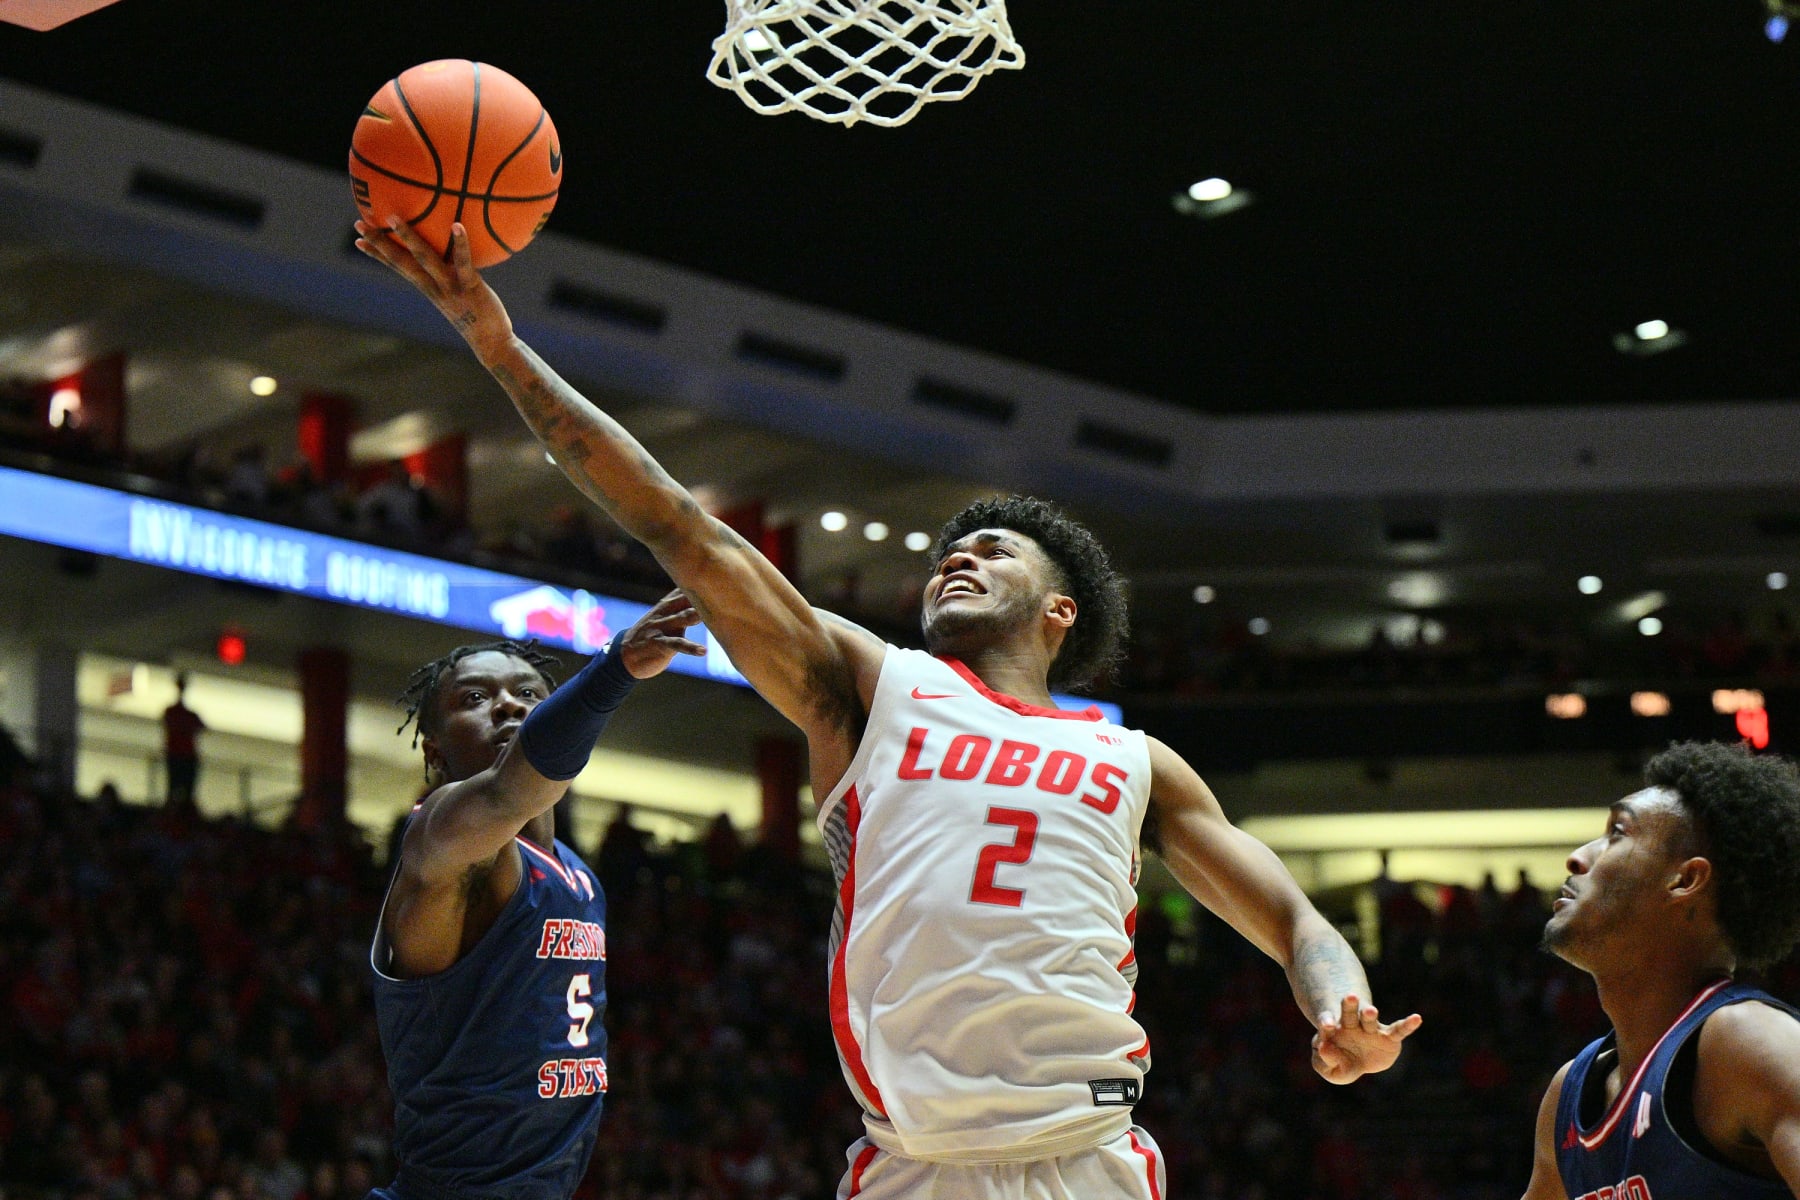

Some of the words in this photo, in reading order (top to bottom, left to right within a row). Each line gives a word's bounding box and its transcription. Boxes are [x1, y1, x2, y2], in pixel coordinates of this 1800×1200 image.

[897, 727, 1129, 815] LOBOS
[967, 803, 1041, 910] 2
[566, 973, 595, 1048] 5
[538, 1057, 608, 1098] STATE
